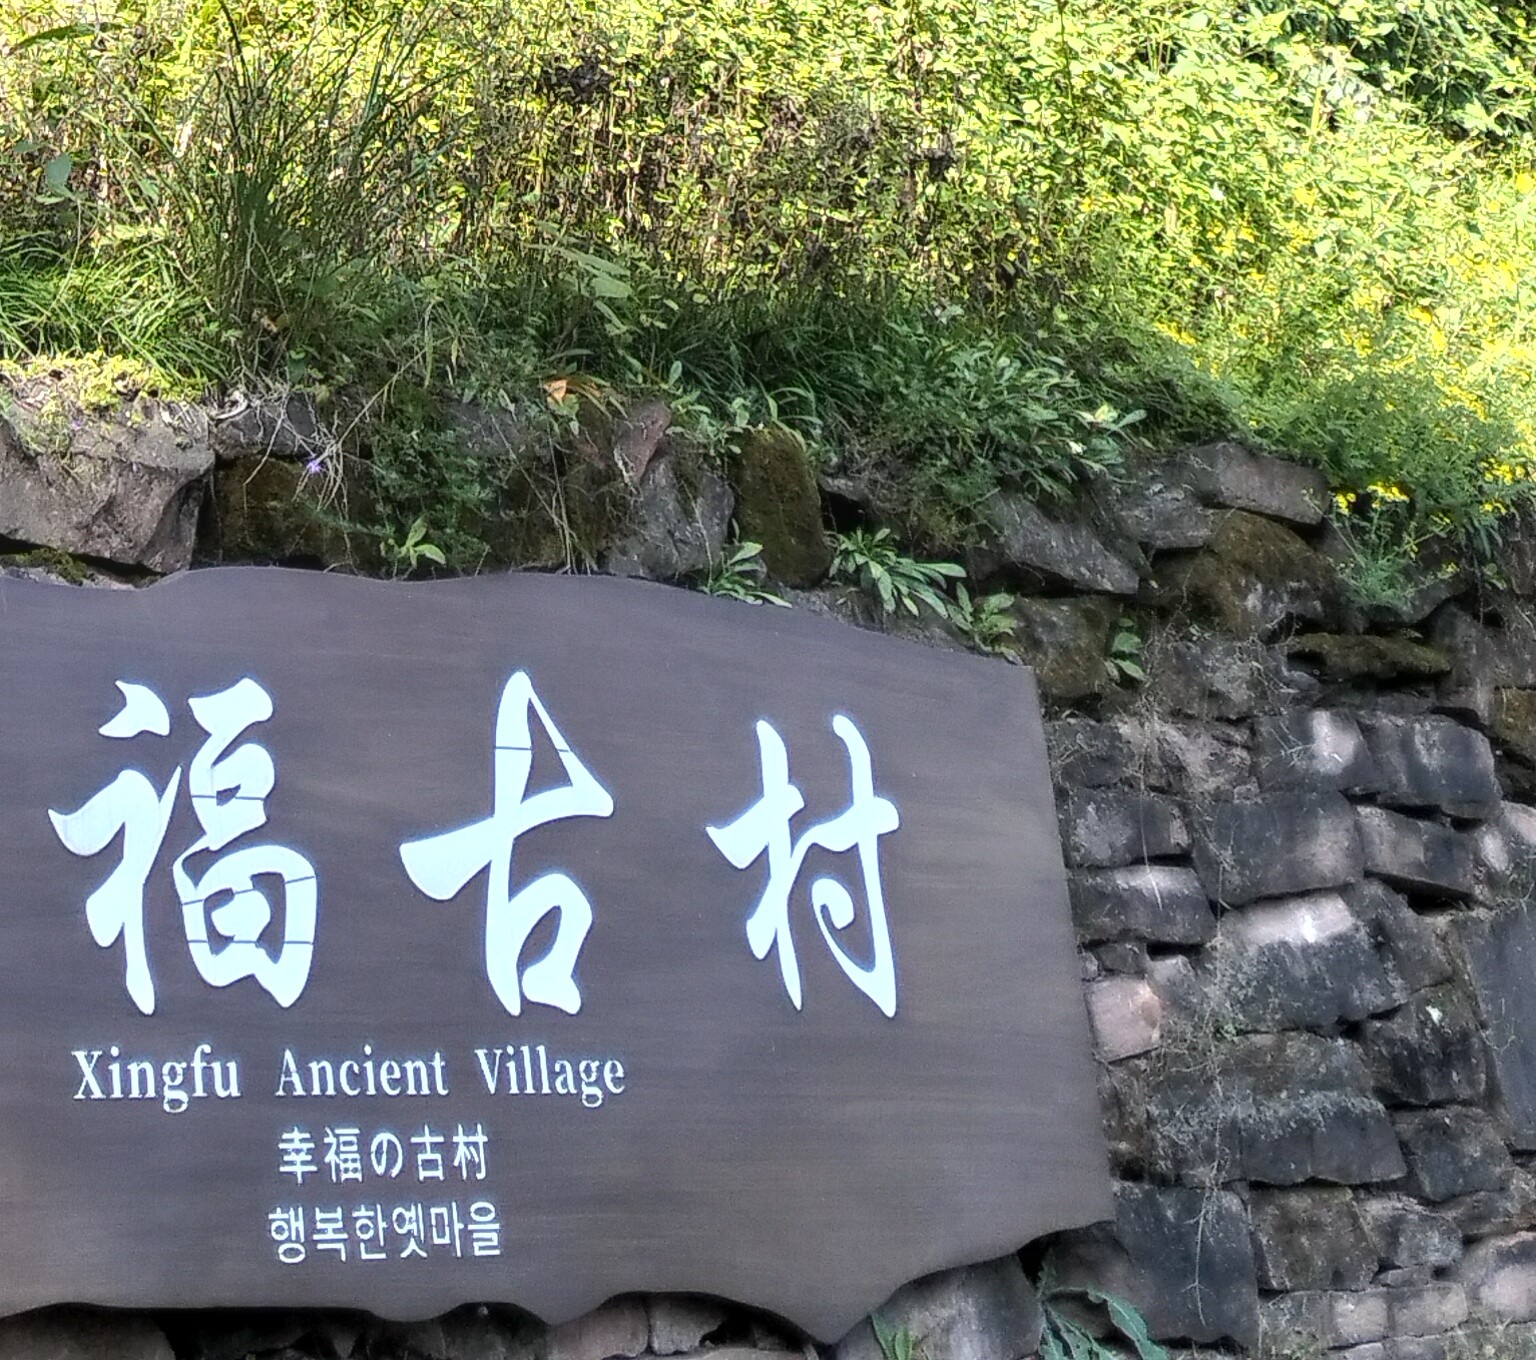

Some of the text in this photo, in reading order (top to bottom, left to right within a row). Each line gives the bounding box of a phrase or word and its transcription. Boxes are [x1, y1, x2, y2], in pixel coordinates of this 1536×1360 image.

[70, 1043, 626, 1114] Xingfu Ancient Village
[277, 1123, 489, 1184] 幸福の古村
[267, 1201, 501, 1264] 행복한옛마을
